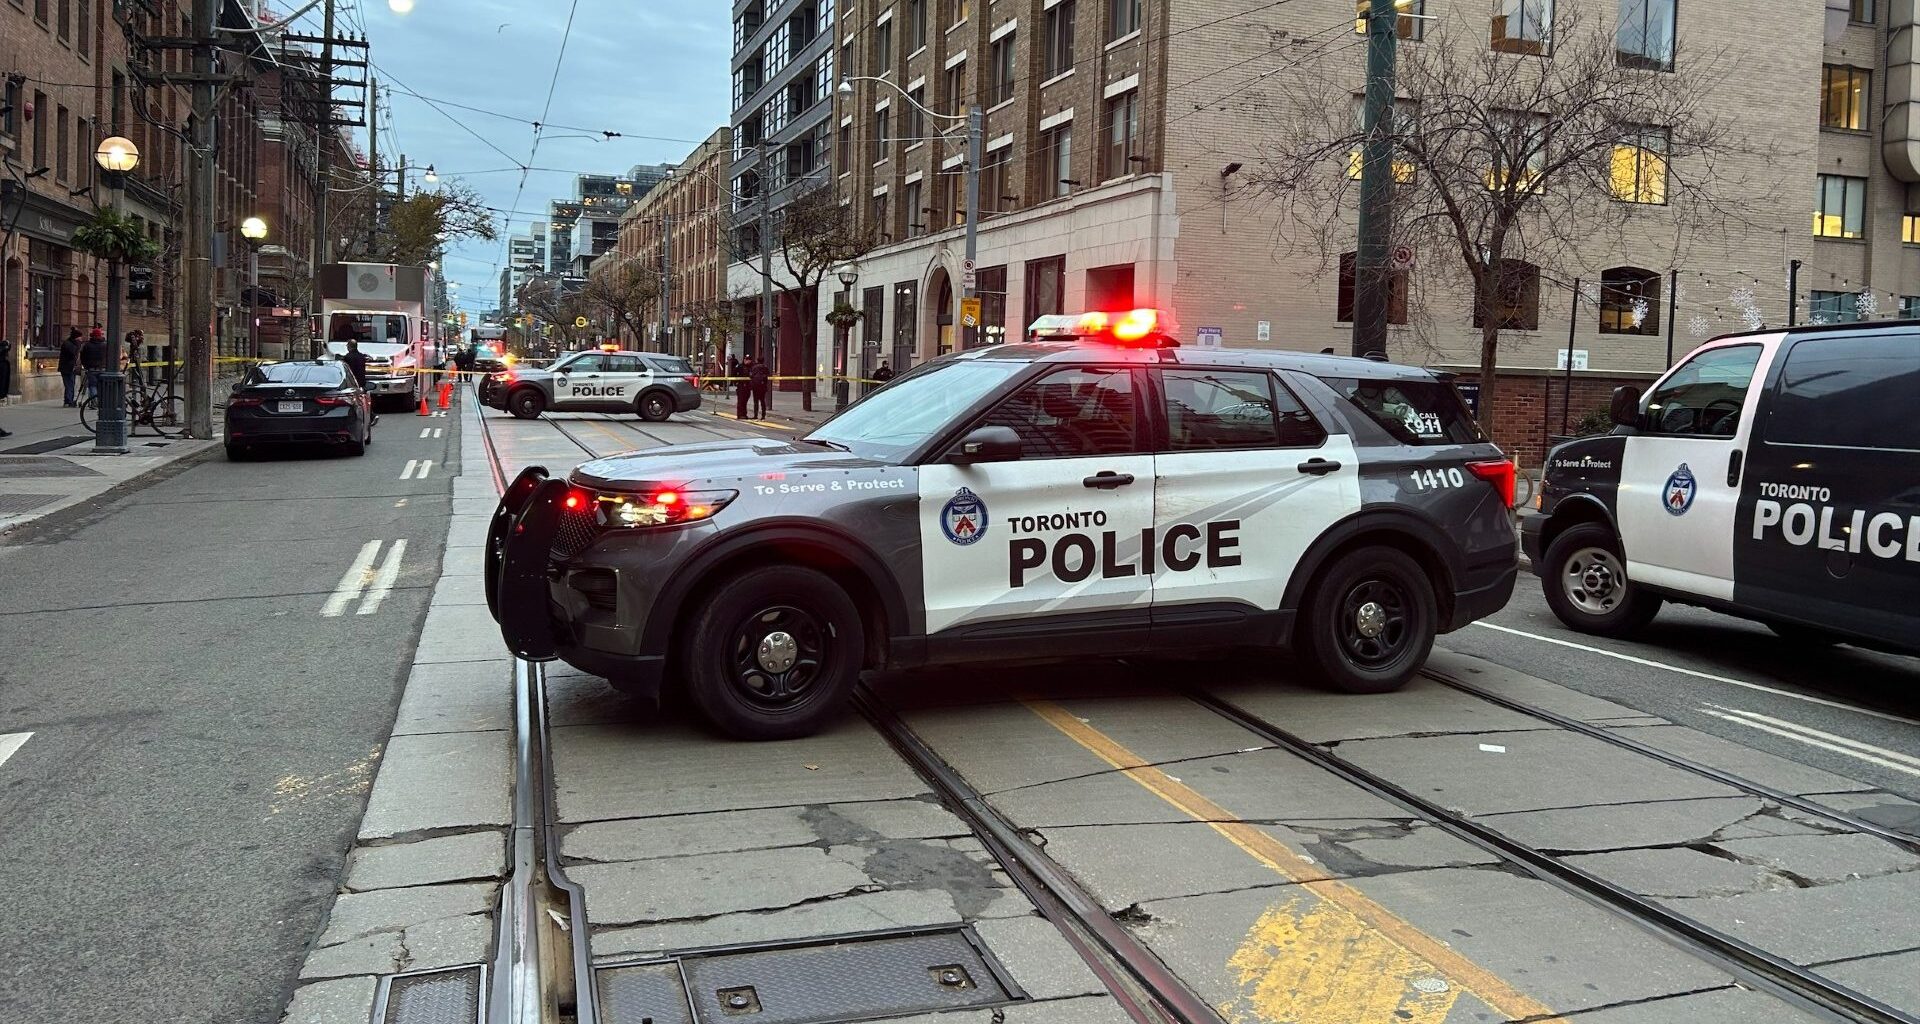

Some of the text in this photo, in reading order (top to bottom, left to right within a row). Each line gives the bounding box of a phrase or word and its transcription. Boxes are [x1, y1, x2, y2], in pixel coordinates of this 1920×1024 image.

[572, 387, 625, 396] POLICE
[1555, 459, 1612, 468] To Serve & Protect
[754, 478, 905, 496] To Serve & Protect
[1410, 468, 1465, 490] 1410
[1760, 482, 1831, 502] TORONTO
[1007, 510, 1107, 534] TORONTO
[1009, 519, 1242, 588] POLICE
